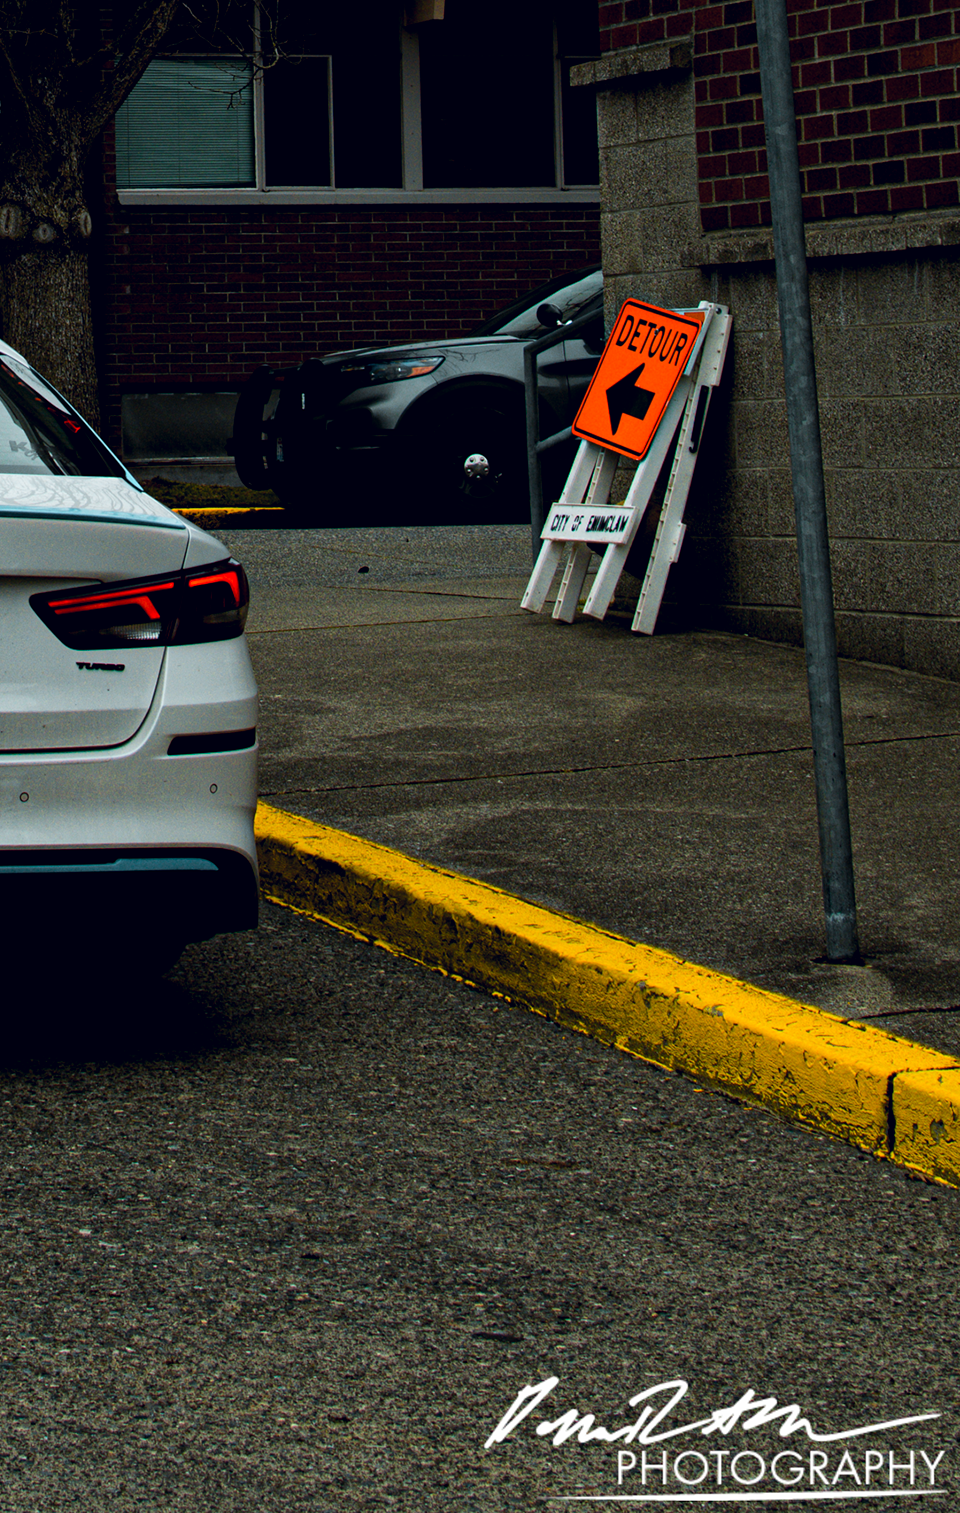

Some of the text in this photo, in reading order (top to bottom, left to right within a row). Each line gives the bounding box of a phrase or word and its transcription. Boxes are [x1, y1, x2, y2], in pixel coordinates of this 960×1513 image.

[615, 314, 689, 366] DETOUR
[550, 514, 570, 532] CITY
[571, 515, 584, 532] OF
[75, 661, 126, 672] TURBO
